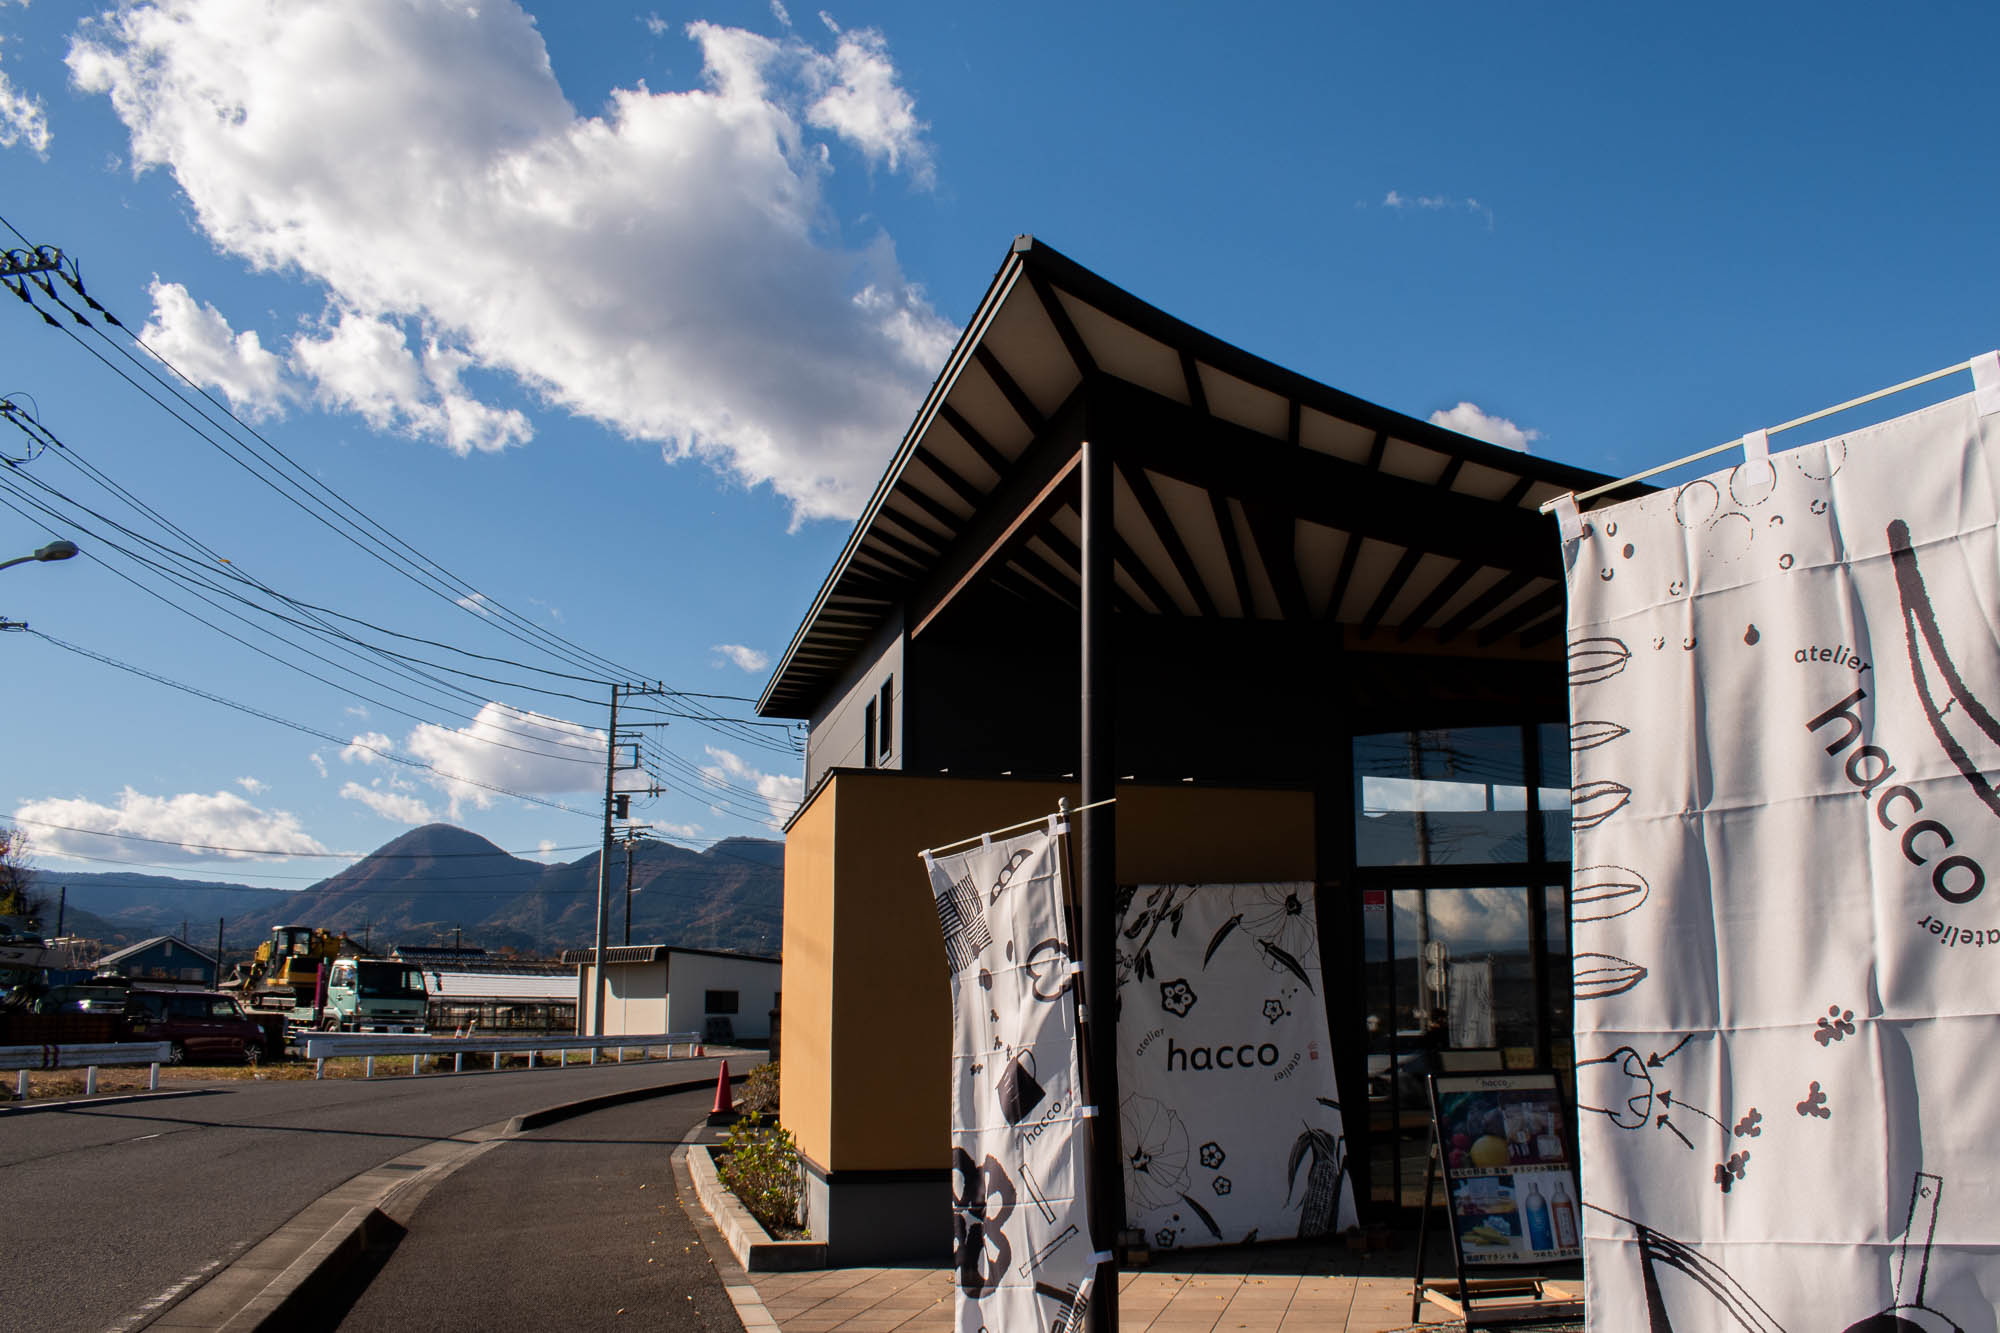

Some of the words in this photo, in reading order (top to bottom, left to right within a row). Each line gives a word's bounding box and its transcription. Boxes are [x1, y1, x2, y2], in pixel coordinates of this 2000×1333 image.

[1794, 644, 1872, 674] atelier
[1806, 688, 1985, 904] hacco
[1917, 915, 2000, 948] atelier
[1136, 1028, 1165, 1056] atelier
[1167, 1038, 1279, 1072] hacco
[1274, 1052, 1300, 1081] atelier
[1023, 1102, 1062, 1145] hacco
